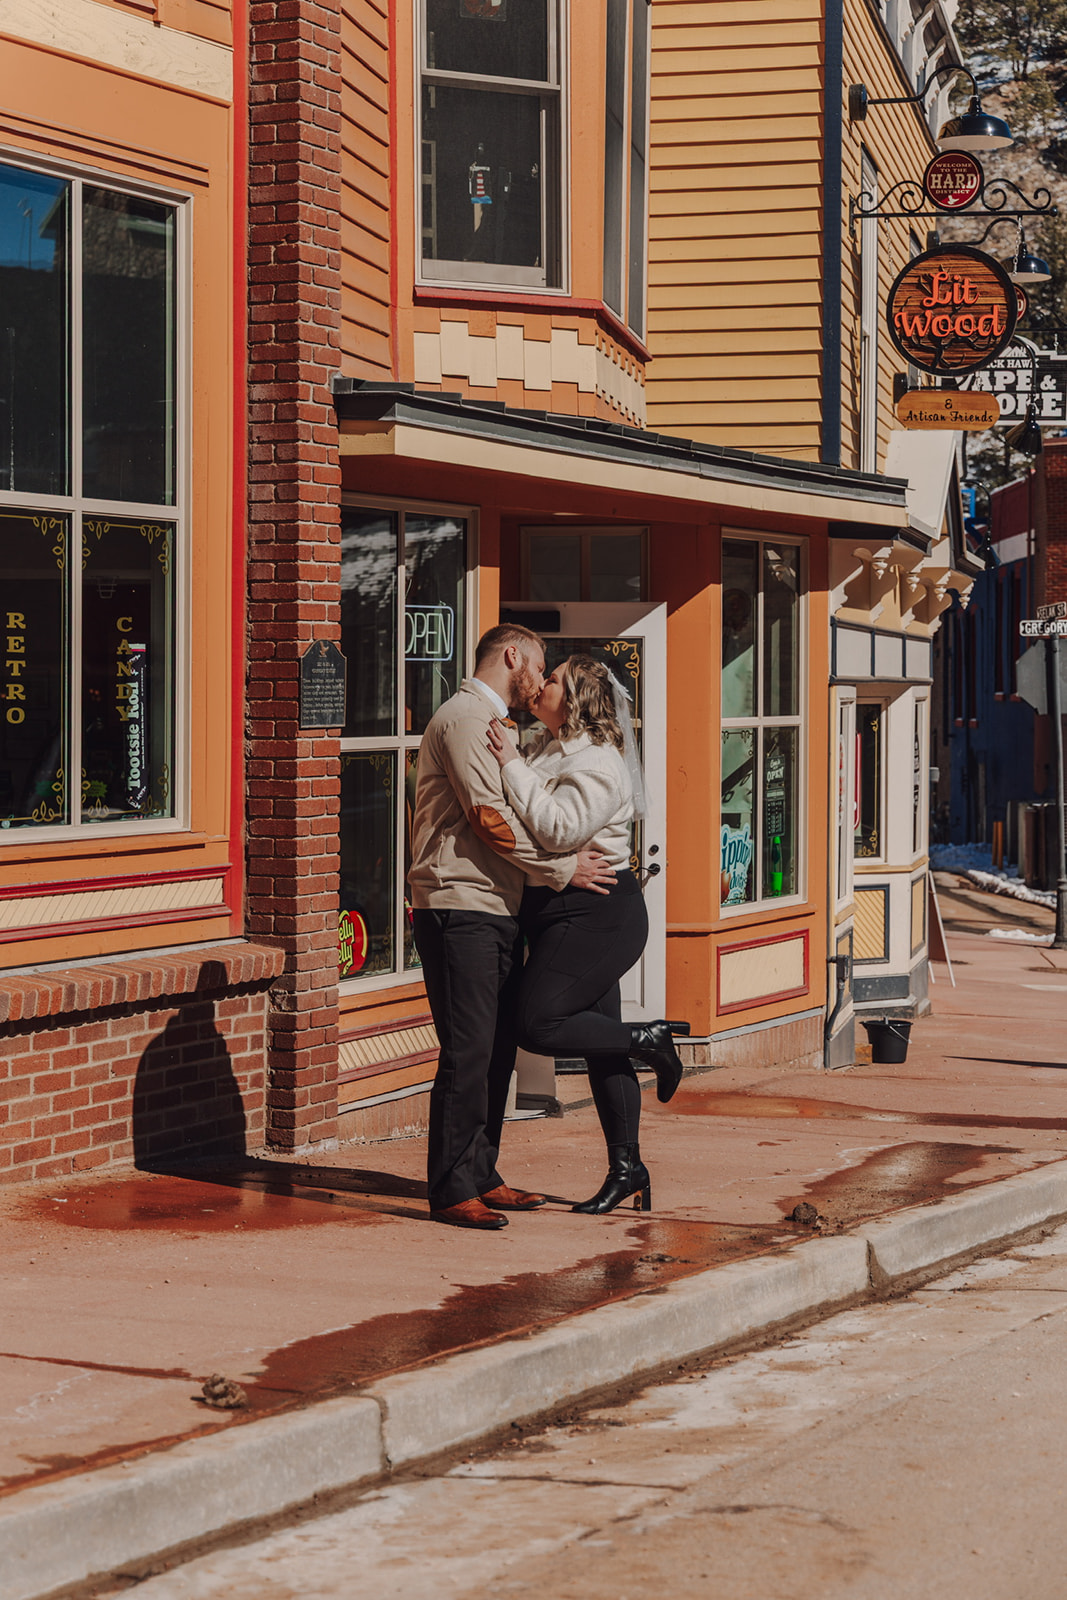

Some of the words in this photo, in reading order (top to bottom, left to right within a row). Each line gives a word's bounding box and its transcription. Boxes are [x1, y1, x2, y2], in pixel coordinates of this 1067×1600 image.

[930, 173, 977, 189] HARD
[922, 271, 980, 307] Lit
[894, 305, 1006, 338] Wood
[1040, 374, 1057, 391] &
[903, 410, 947, 423] Artisan
[949, 410, 993, 423] Friends
[944, 398, 953, 410] &
[1025, 622, 1067, 634] GREGORY
[5, 612, 26, 724] RETRO
[116, 616, 133, 722] CANDY
[127, 723, 141, 792] Tootsie
[339, 914, 355, 944] elly
